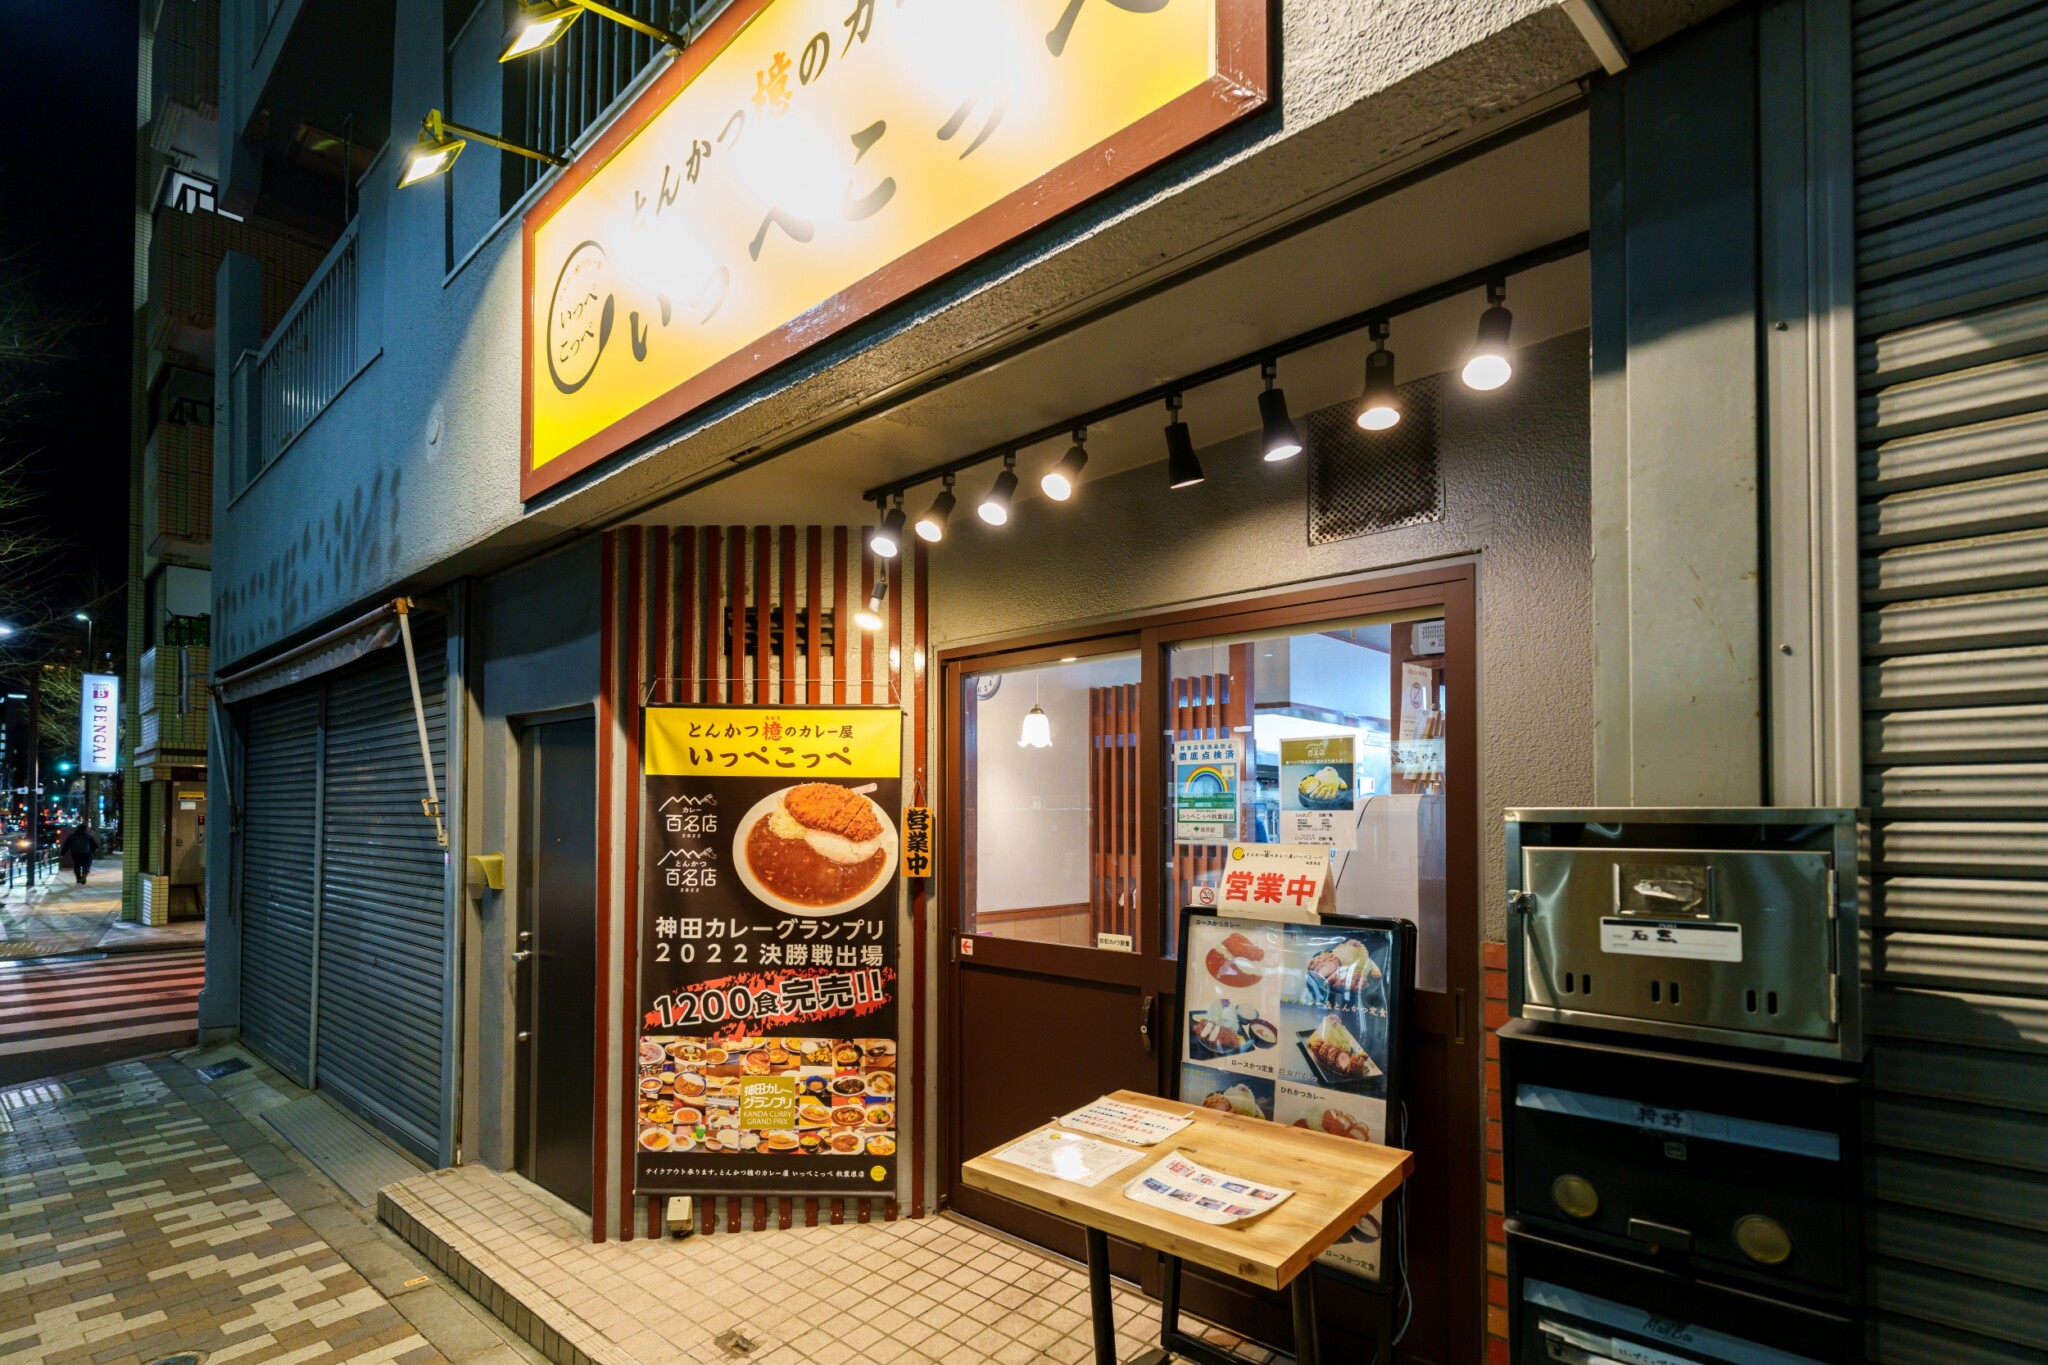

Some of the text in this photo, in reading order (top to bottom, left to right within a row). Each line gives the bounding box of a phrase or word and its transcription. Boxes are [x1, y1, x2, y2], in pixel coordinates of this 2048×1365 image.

[92, 705, 107, 763] BENGAL
[688, 721, 853, 741] とんかつ檍のカレー屋
[688, 746, 852, 768] いっぺこっぺ
[1178, 750, 1234, 761] 徹底点検済
[665, 814, 718, 832] 百名店
[907, 808, 929, 876] 営業中
[675, 860, 707, 868] とんかつ
[665, 868, 717, 887] 百名店
[1225, 870, 1317, 907] 営業中
[655, 916, 884, 941] 神田カレーグランプリ
[1195, 919, 1241, 928] ロースかつカレー
[1231, 1059, 1274, 1074] ロースかつ定食
[744, 1083, 792, 1096] 神田カレー
[1280, 1086, 1327, 1101] ひれかつカレー
[743, 1096, 793, 1109] グランプリ
[743, 1110, 792, 1118] KANDA CURRY
[746, 1117, 788, 1125] GRAND PRIX
[836, 1168, 865, 1178] 秋葉原店
[1325, 1249, 1376, 1273] ロースかつ定食
[1671, 1325, 1695, 1344] Box
